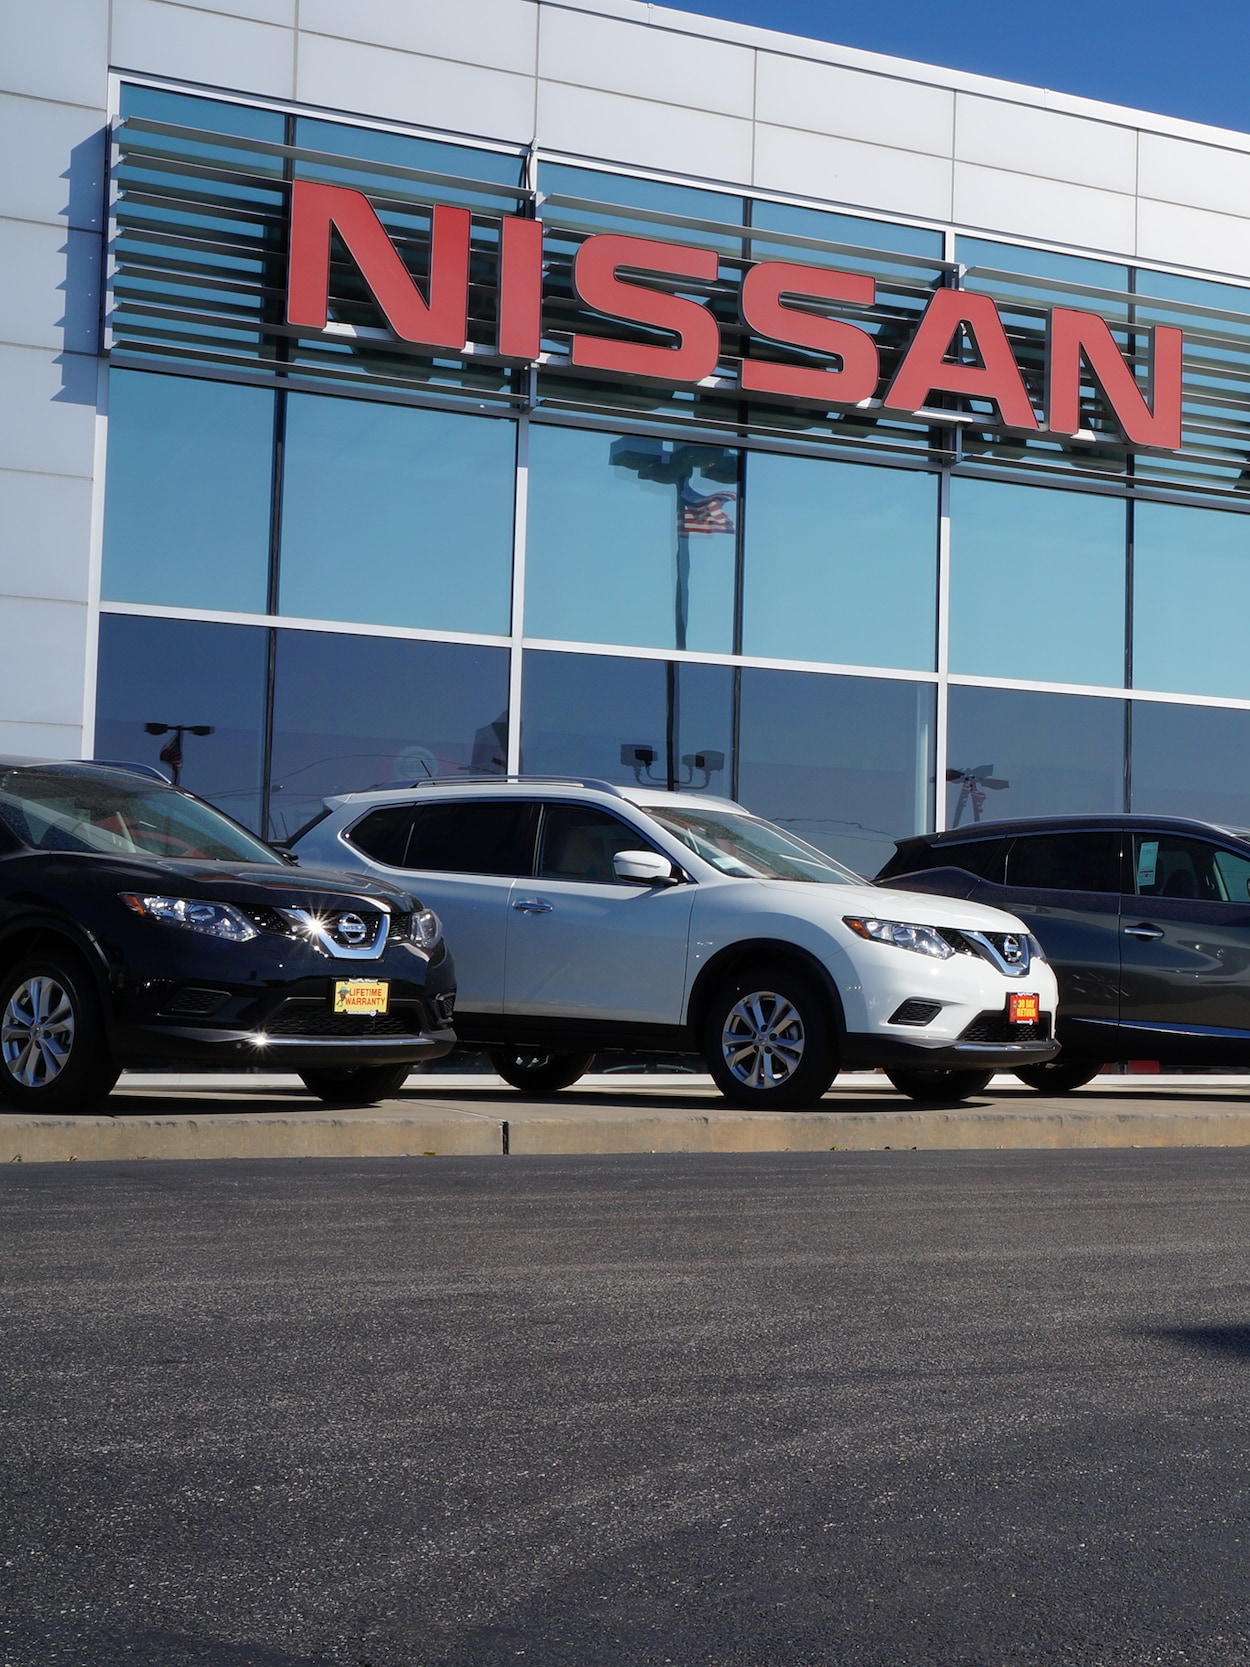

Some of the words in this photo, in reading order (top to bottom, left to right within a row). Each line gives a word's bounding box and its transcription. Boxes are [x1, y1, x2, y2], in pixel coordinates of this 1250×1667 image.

[286, 178, 1183, 450] NISSAN
[349, 988, 382, 997] LIFETIME
[345, 997, 386, 1006] WARRANTY
